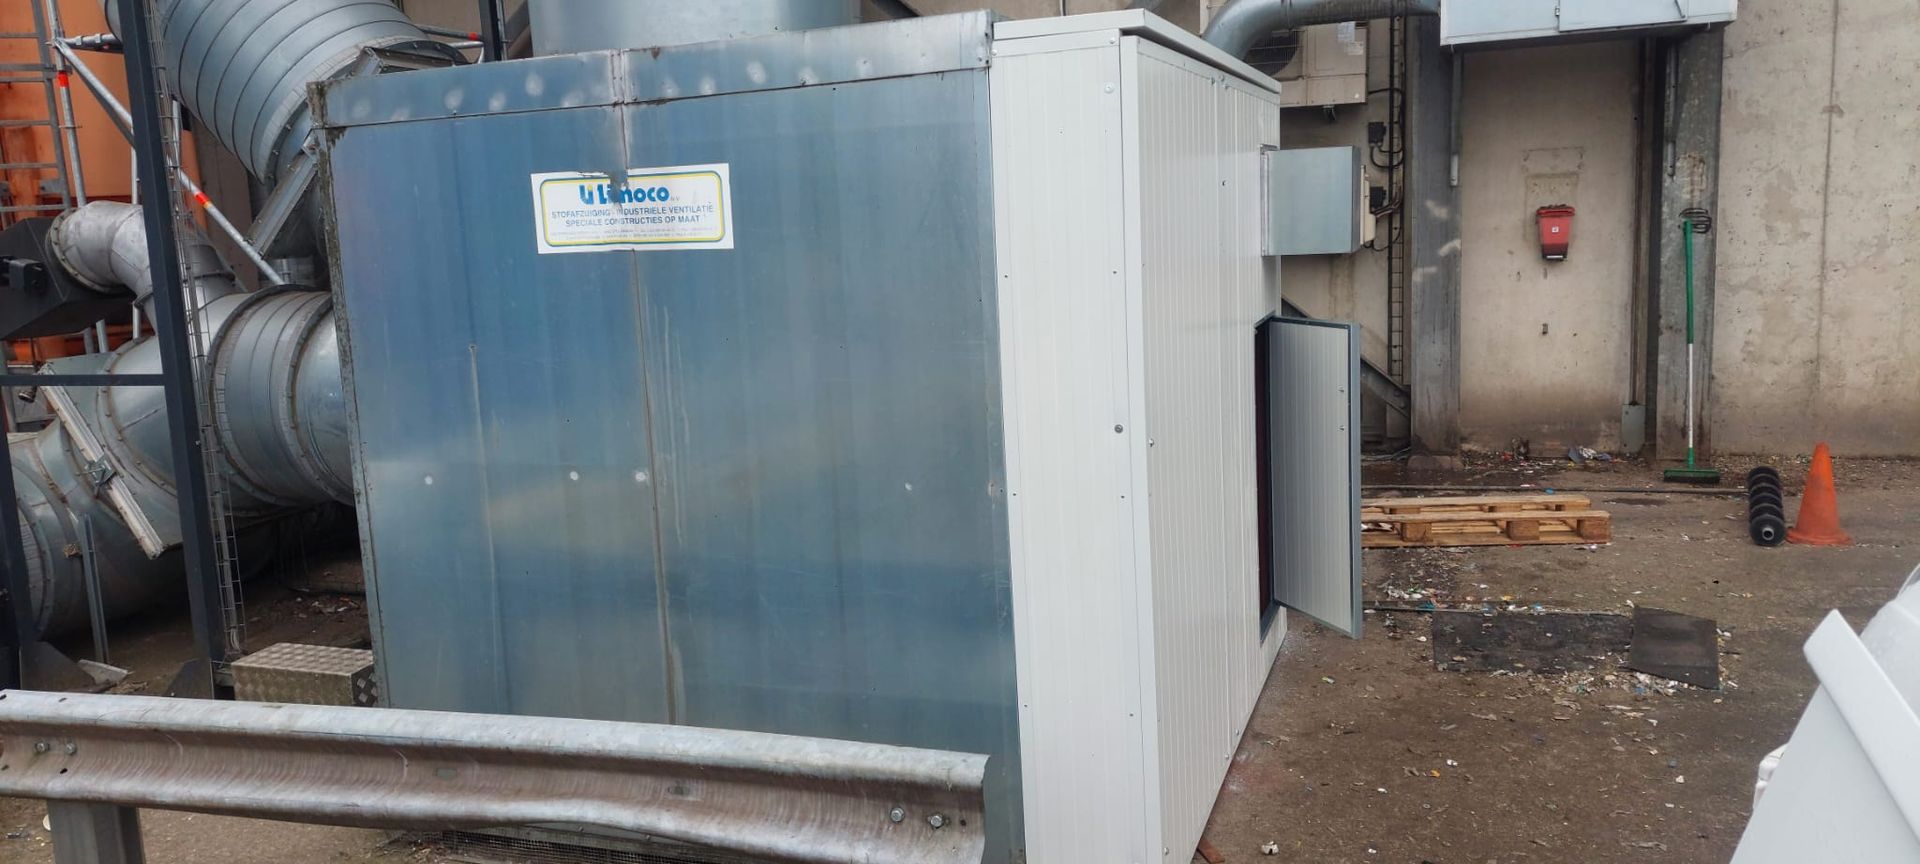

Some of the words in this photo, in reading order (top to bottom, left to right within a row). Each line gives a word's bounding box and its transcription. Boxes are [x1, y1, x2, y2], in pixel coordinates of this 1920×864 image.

[565, 217, 603, 227] SPECIALE
[665, 215, 676, 224] OP
[677, 214, 701, 223] MAAT
